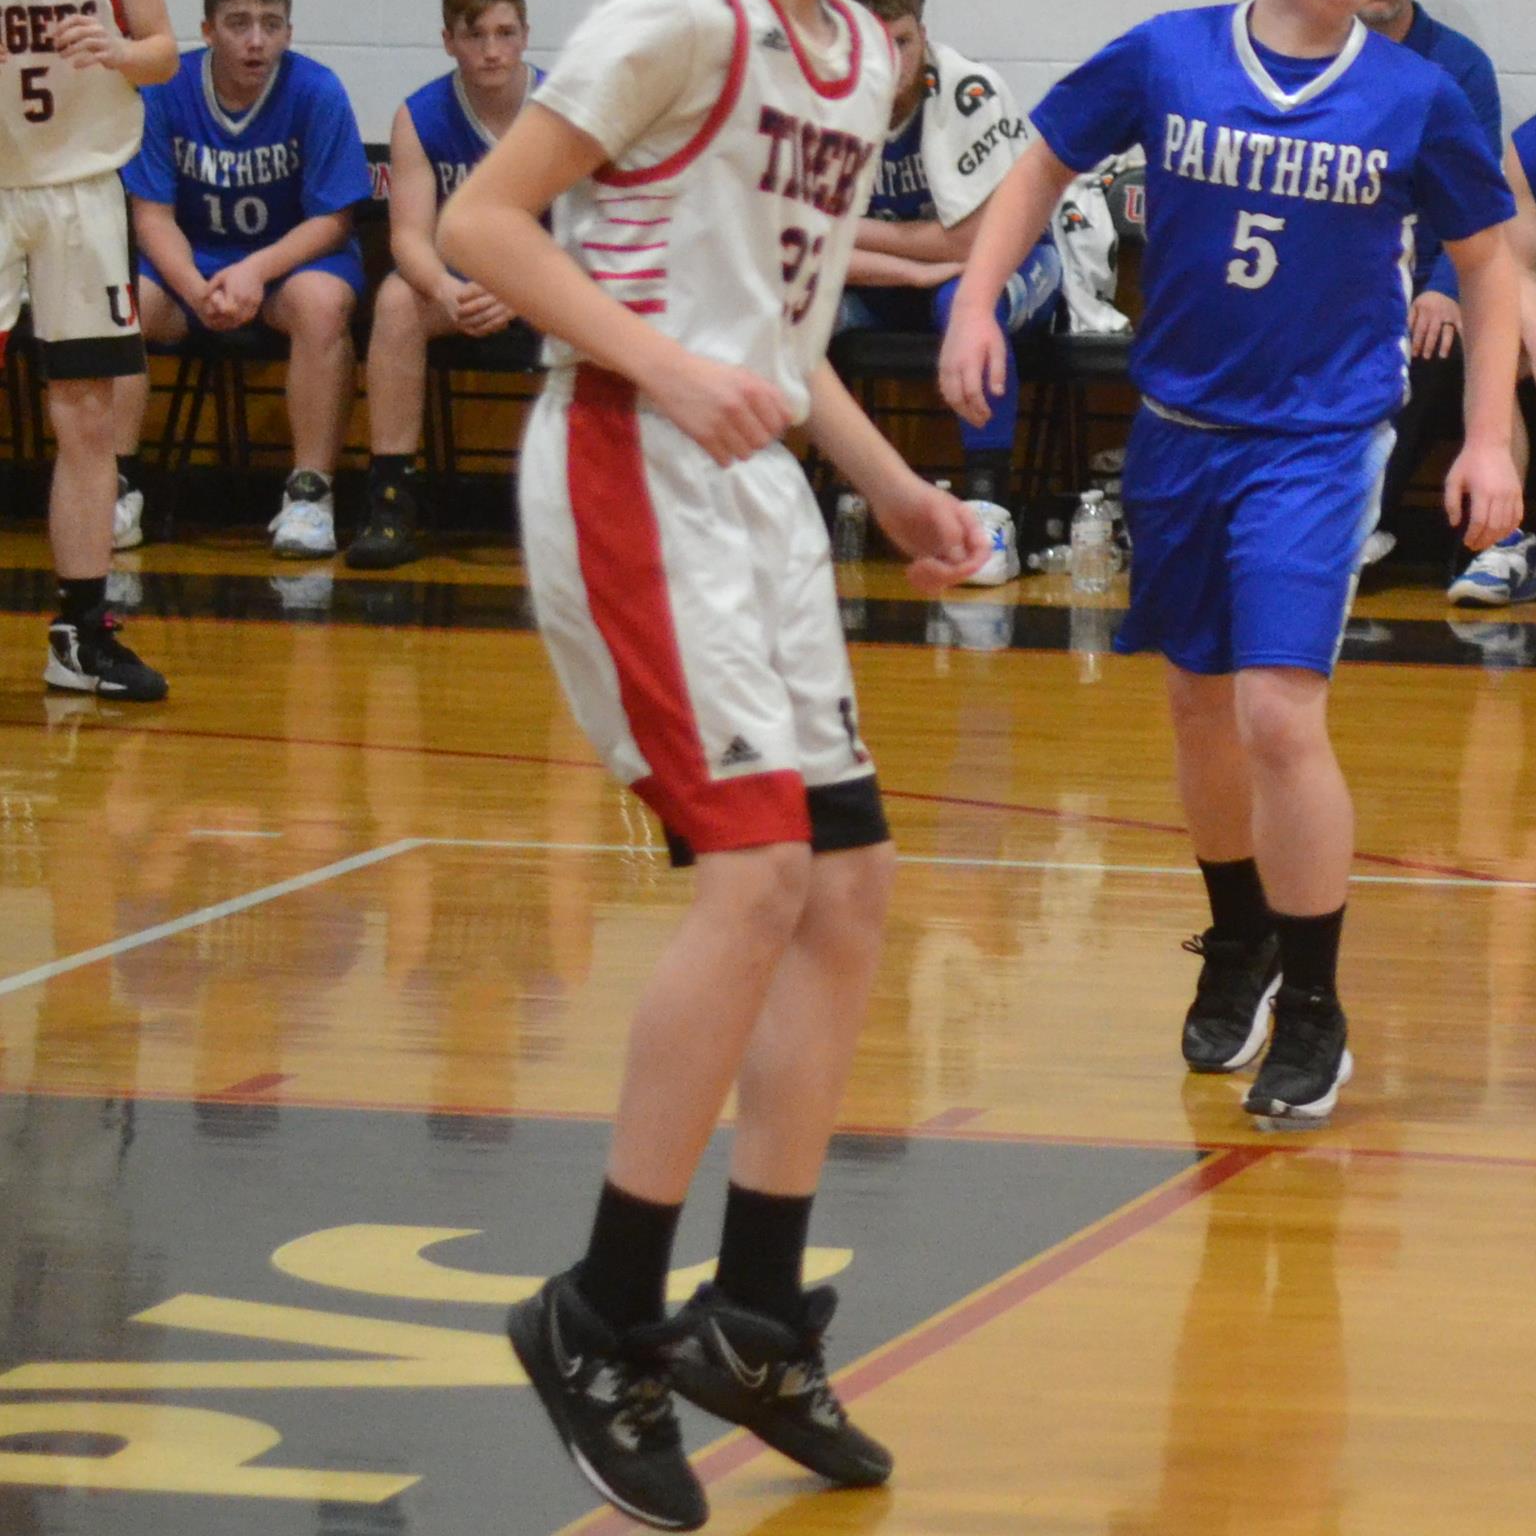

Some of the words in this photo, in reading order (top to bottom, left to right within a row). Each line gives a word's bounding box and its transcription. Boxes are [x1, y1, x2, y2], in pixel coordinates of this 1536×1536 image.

[21, 67, 54, 123] 5
[174, 136, 299, 187] PANTHERS
[1163, 113, 1389, 204] PANTHERS
[203, 193, 268, 235] 10
[1226, 210, 1286, 289] 5
[106, 283, 137, 326] U
